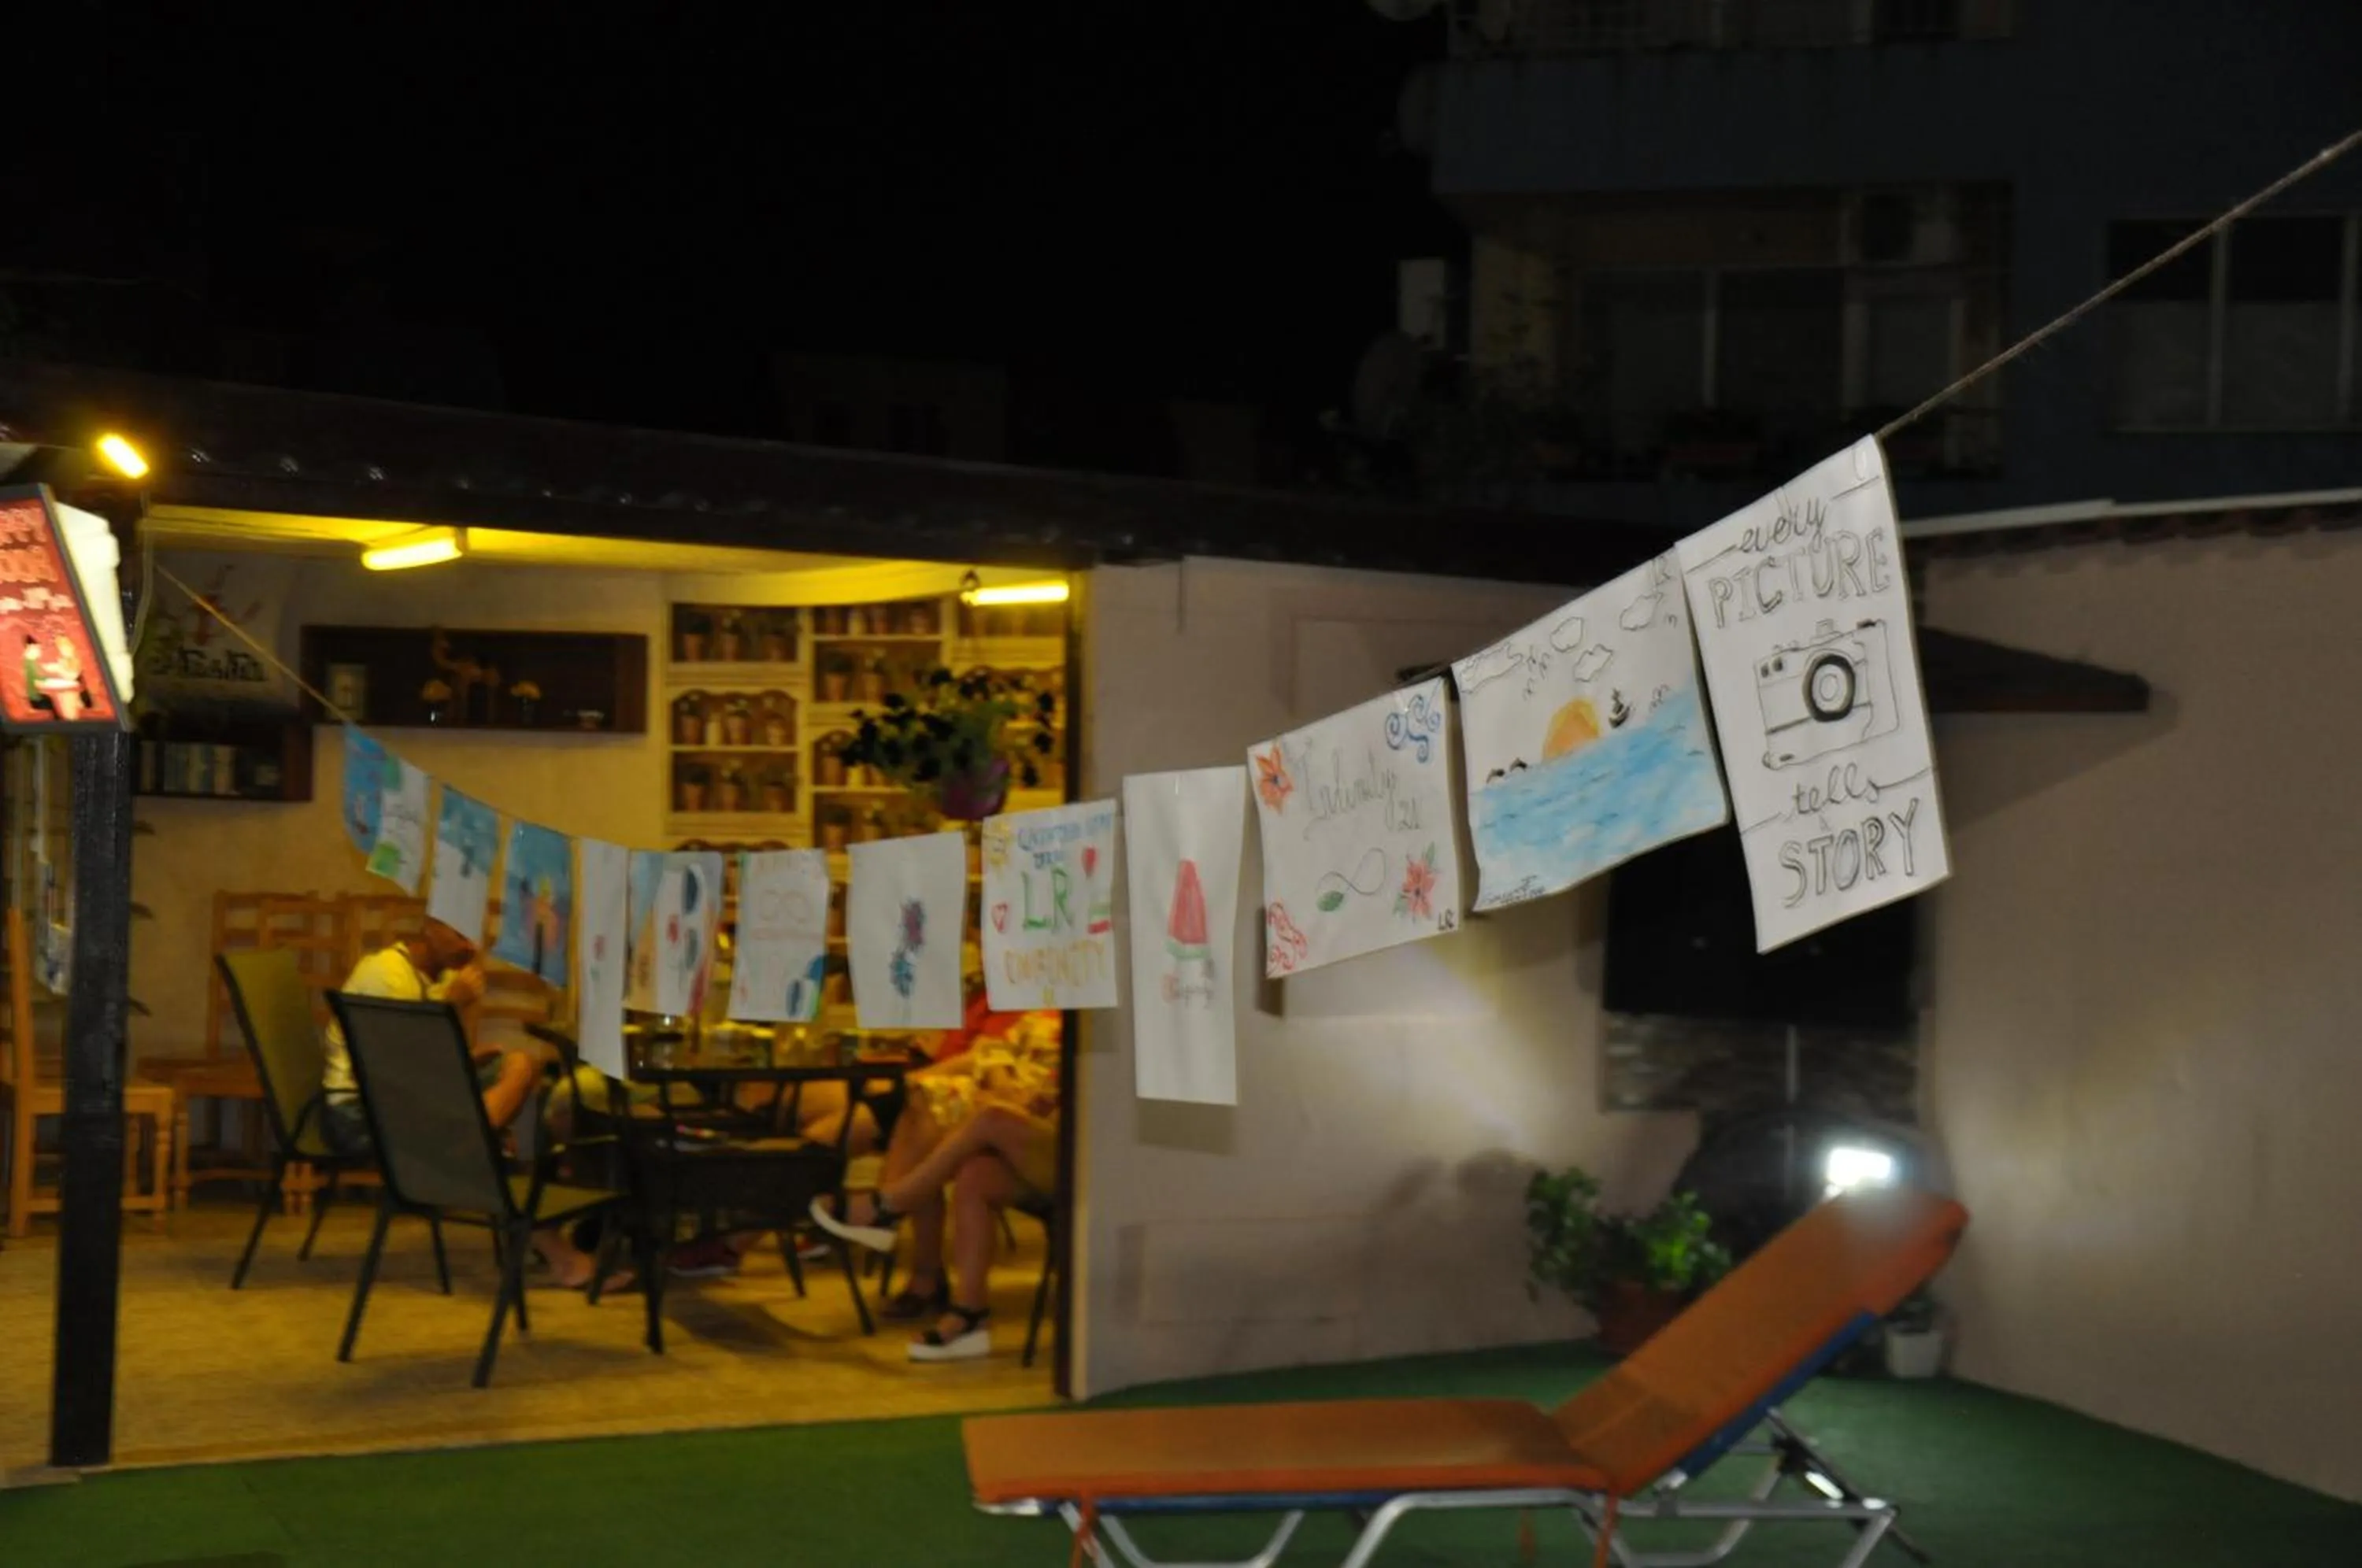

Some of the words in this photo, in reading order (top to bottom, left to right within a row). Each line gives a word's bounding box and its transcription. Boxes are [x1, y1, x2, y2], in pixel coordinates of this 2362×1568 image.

[1737, 497, 1828, 553] every
[1708, 527, 1890, 629] PICTURE
[1791, 763, 1883, 815] tells
[1779, 797, 1920, 908] STORY
[1020, 867, 1075, 934] LR
